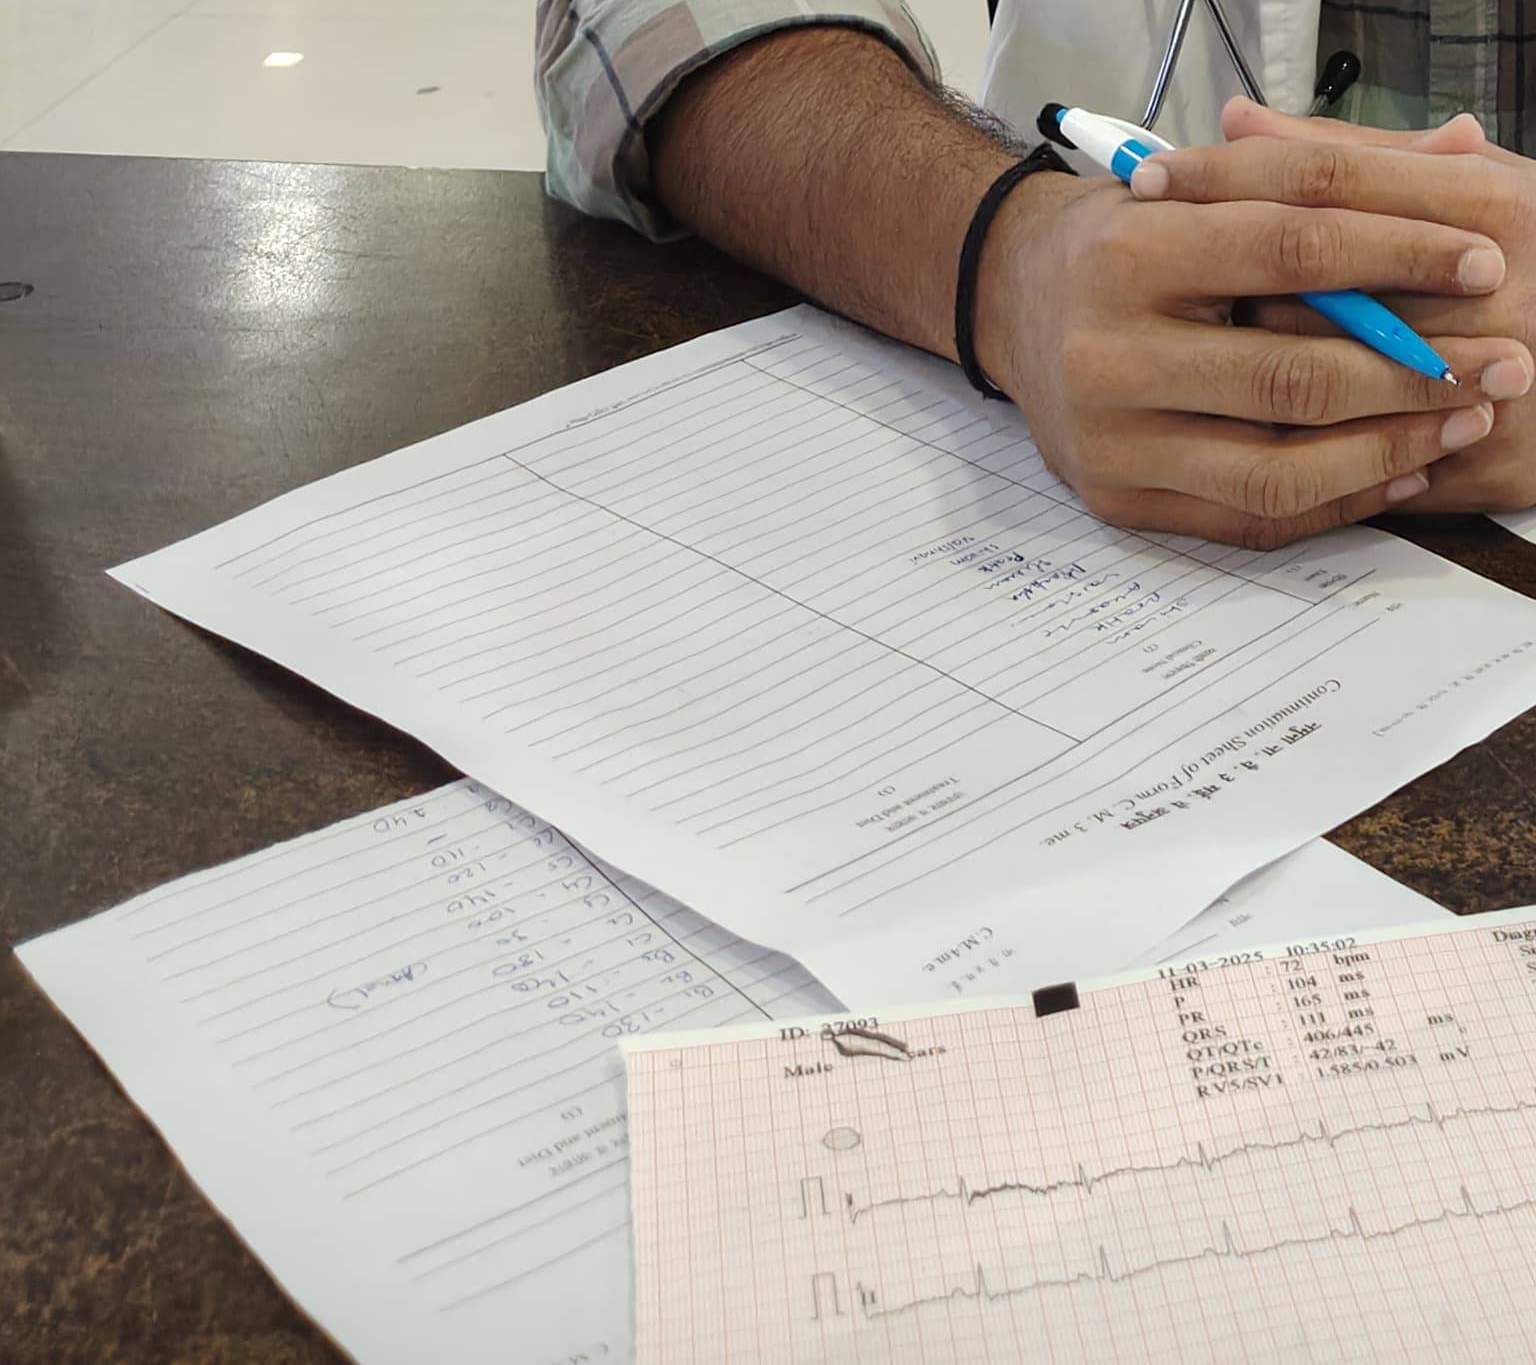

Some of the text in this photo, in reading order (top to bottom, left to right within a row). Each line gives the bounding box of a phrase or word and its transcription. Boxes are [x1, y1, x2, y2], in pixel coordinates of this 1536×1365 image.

[1243, 679, 1342, 738] Continuation
[1199, 735, 1247, 766] Sheet
[1134, 774, 1184, 800] Form
[1180, 762, 1200, 782] of
[1157, 937, 1357, 979] 11-03-2025 10:35:02
[1170, 951, 1371, 991] HR 72 bpm
[1174, 971, 1366, 1009] P 104 ms
[1178, 989, 1371, 1026] PR 165 ms
[779, 1026, 810, 1041] ID:
[1182, 1006, 1375, 1044] QRS 111 ms
[1186, 1013, 1454, 1063] QT/QTc 406/445 ms
[784, 1044, 948, 1078] Male ears
[1192, 1056, 1272, 1081] P/QRS/T
[1196, 1046, 1470, 1099] RV5/SV1 1.585/0.503 mV
